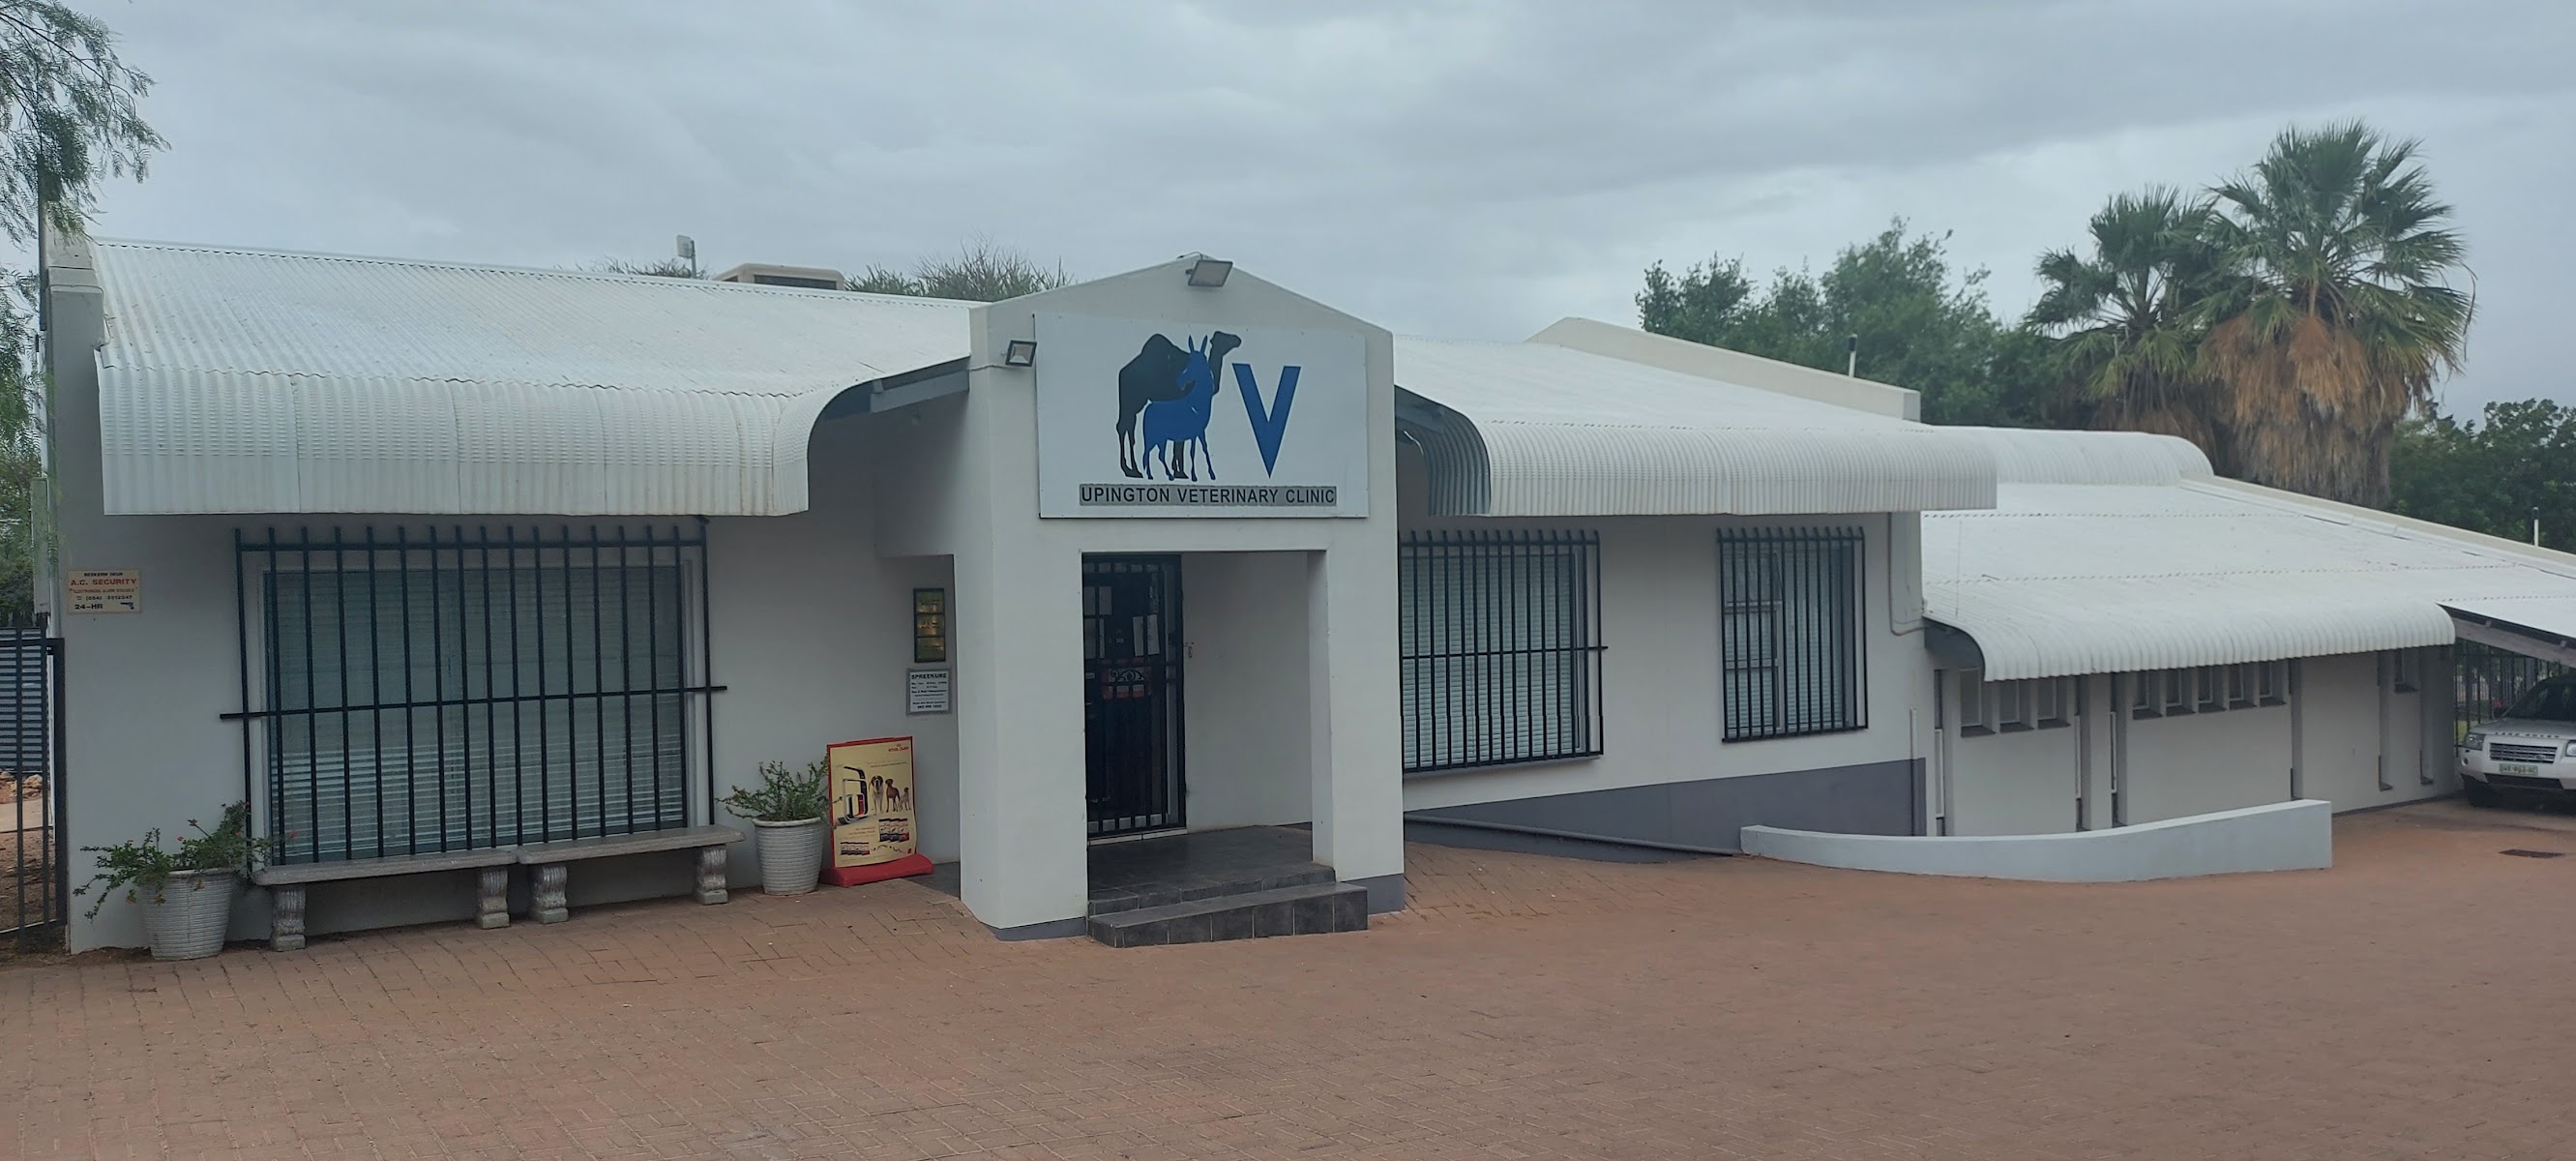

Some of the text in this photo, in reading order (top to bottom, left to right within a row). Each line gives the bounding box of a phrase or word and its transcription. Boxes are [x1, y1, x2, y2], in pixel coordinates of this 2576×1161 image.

[1232, 363, 1301, 479] V
[1081, 487, 1335, 503] UPINGTON VETERINARY CLINIC
